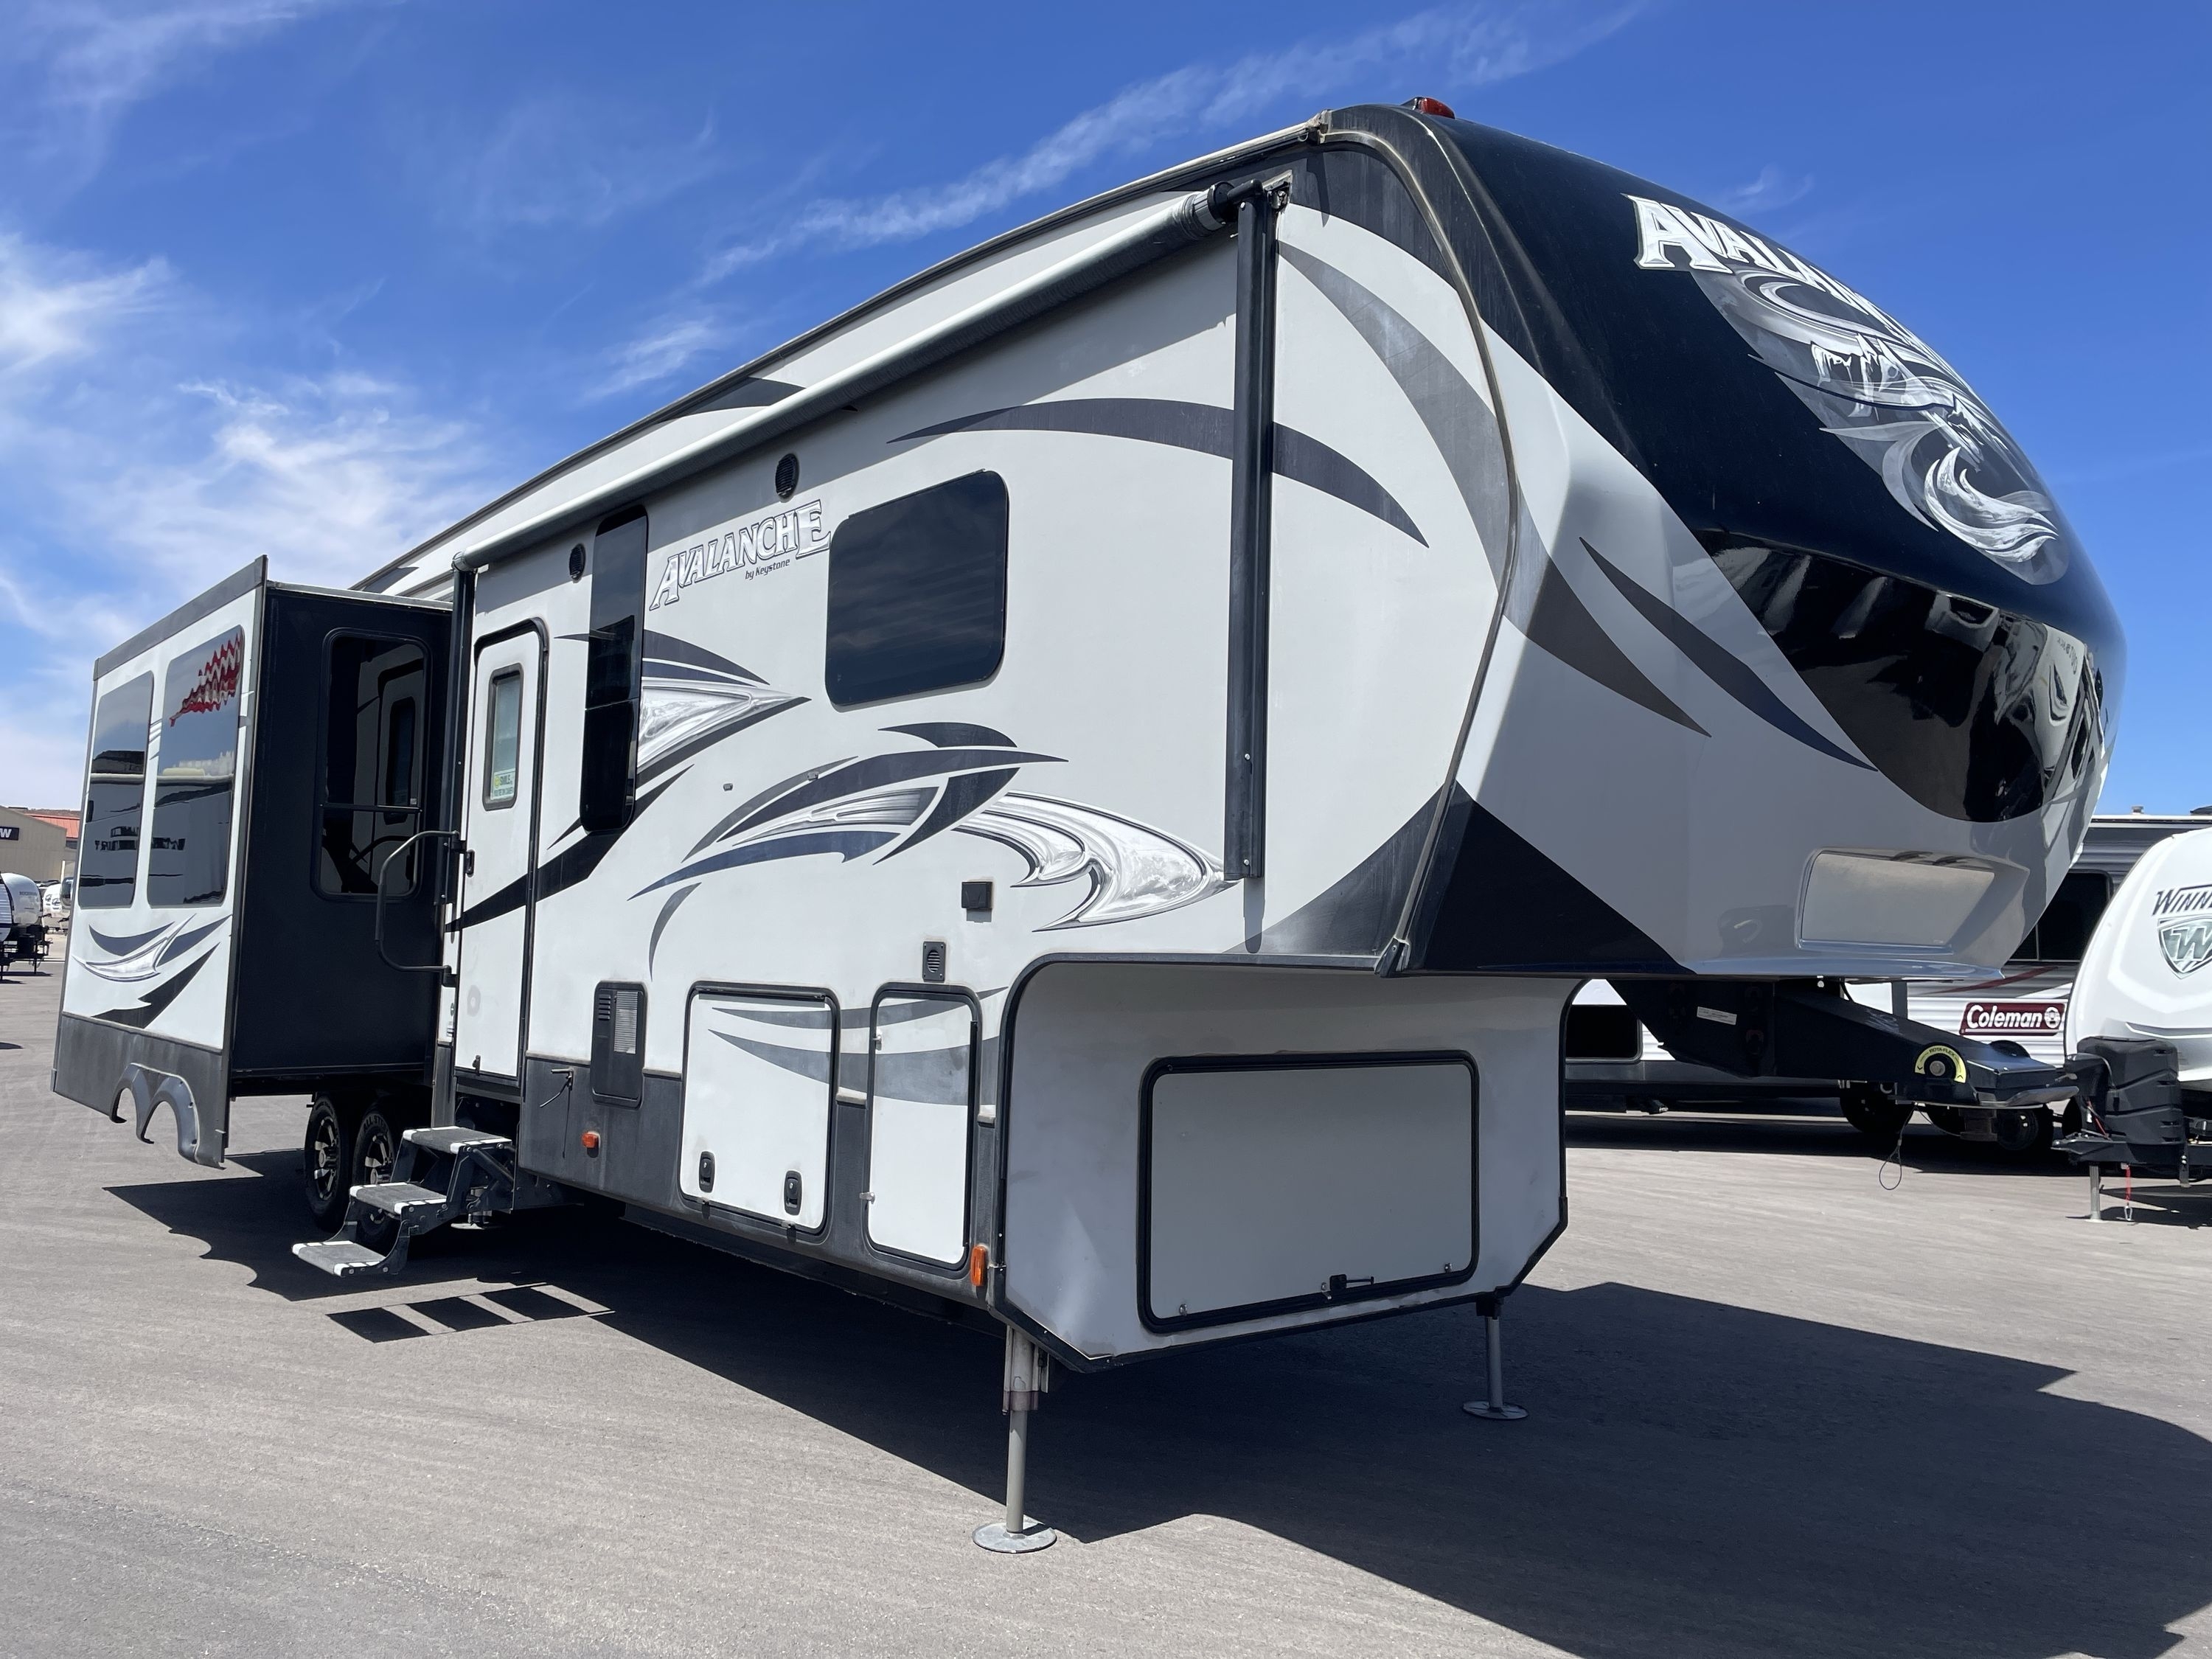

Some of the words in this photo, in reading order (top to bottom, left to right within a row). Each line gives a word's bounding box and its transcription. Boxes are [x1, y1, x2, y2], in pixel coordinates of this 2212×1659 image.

[650, 499, 832, 611] AVALANCHE
[745, 570, 754, 580] by
[755, 559, 790, 577] Keystone
[1966, 1004, 2042, 1029] Coleman
[1929, 1047, 1955, 1057] ROTA-FLEX
